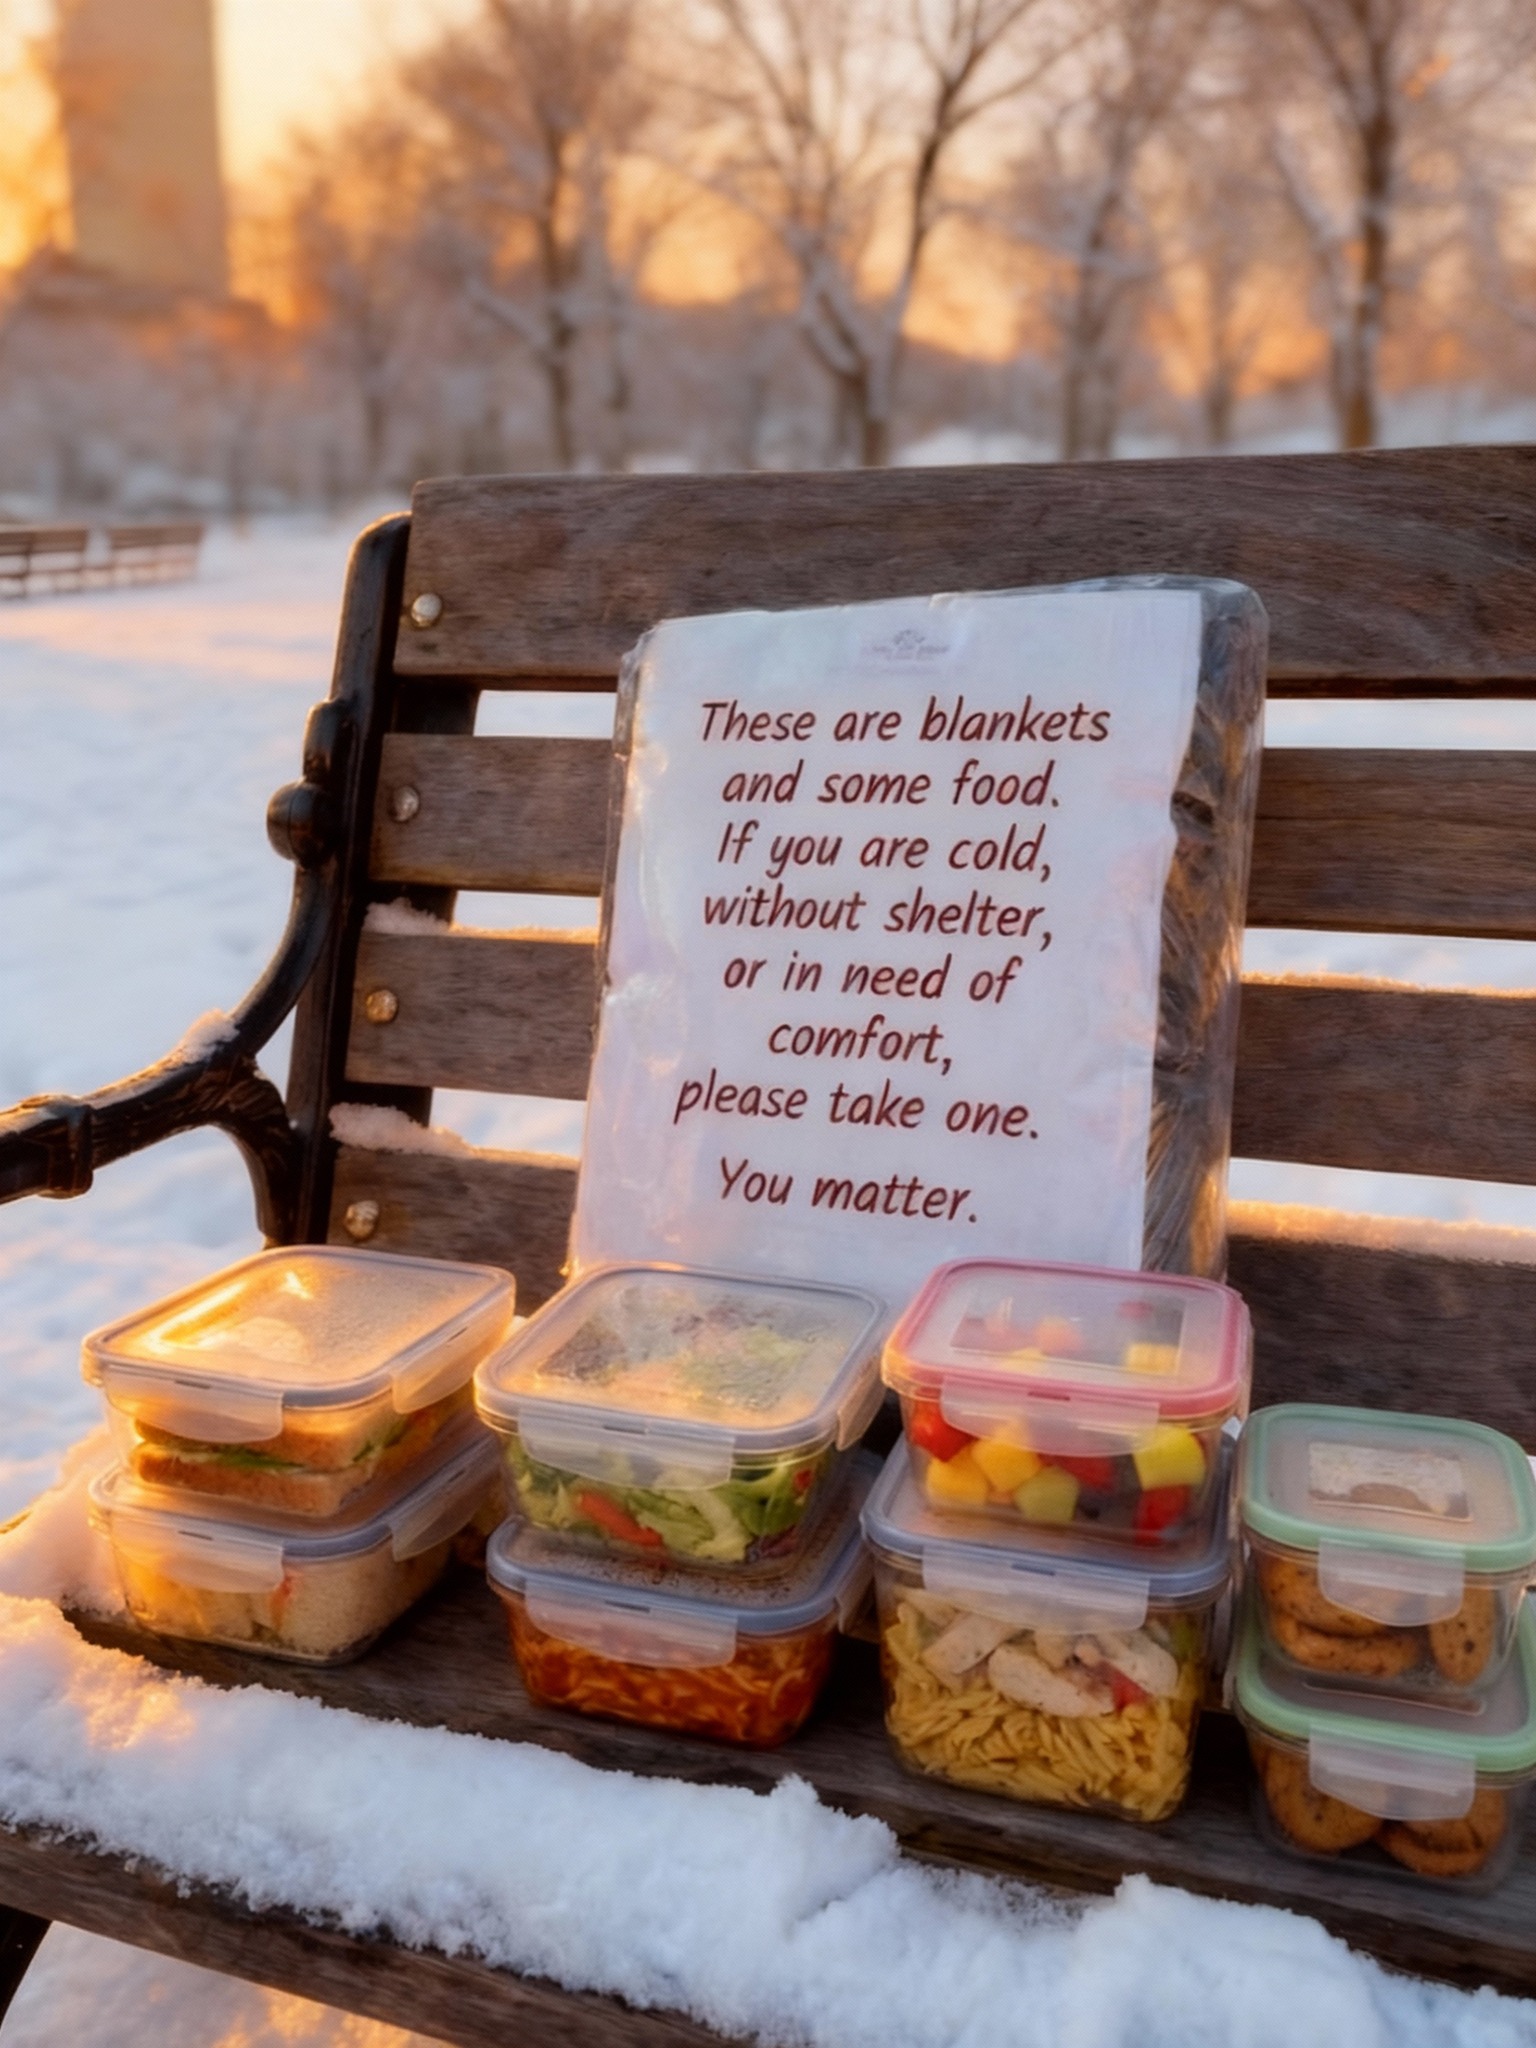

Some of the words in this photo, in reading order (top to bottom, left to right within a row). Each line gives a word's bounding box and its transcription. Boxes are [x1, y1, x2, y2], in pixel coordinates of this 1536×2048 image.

[702, 699, 817, 743] These
[833, 711, 902, 742] are
[919, 695, 1111, 743] blankets
[722, 759, 804, 804] and
[816, 774, 931, 805] some
[953, 758, 1060, 808] food.
[717, 819, 759, 865] If
[766, 831, 841, 878] you
[860, 837, 930, 870] are
[949, 823, 1051, 883] cold,
[704, 883, 867, 932] without
[884, 886, 1052, 951] shelter,
[723, 957, 768, 989] or
[783, 950, 822, 993] in
[841, 952, 952, 1001] need
[968, 955, 1024, 1005] of
[768, 1013, 953, 1076] comfort,
[672, 1067, 808, 1125] please
[830, 1077, 925, 1129] take
[946, 1100, 1039, 1140] one.
[720, 1156, 794, 1206] You
[811, 1173, 978, 1222] matter.
